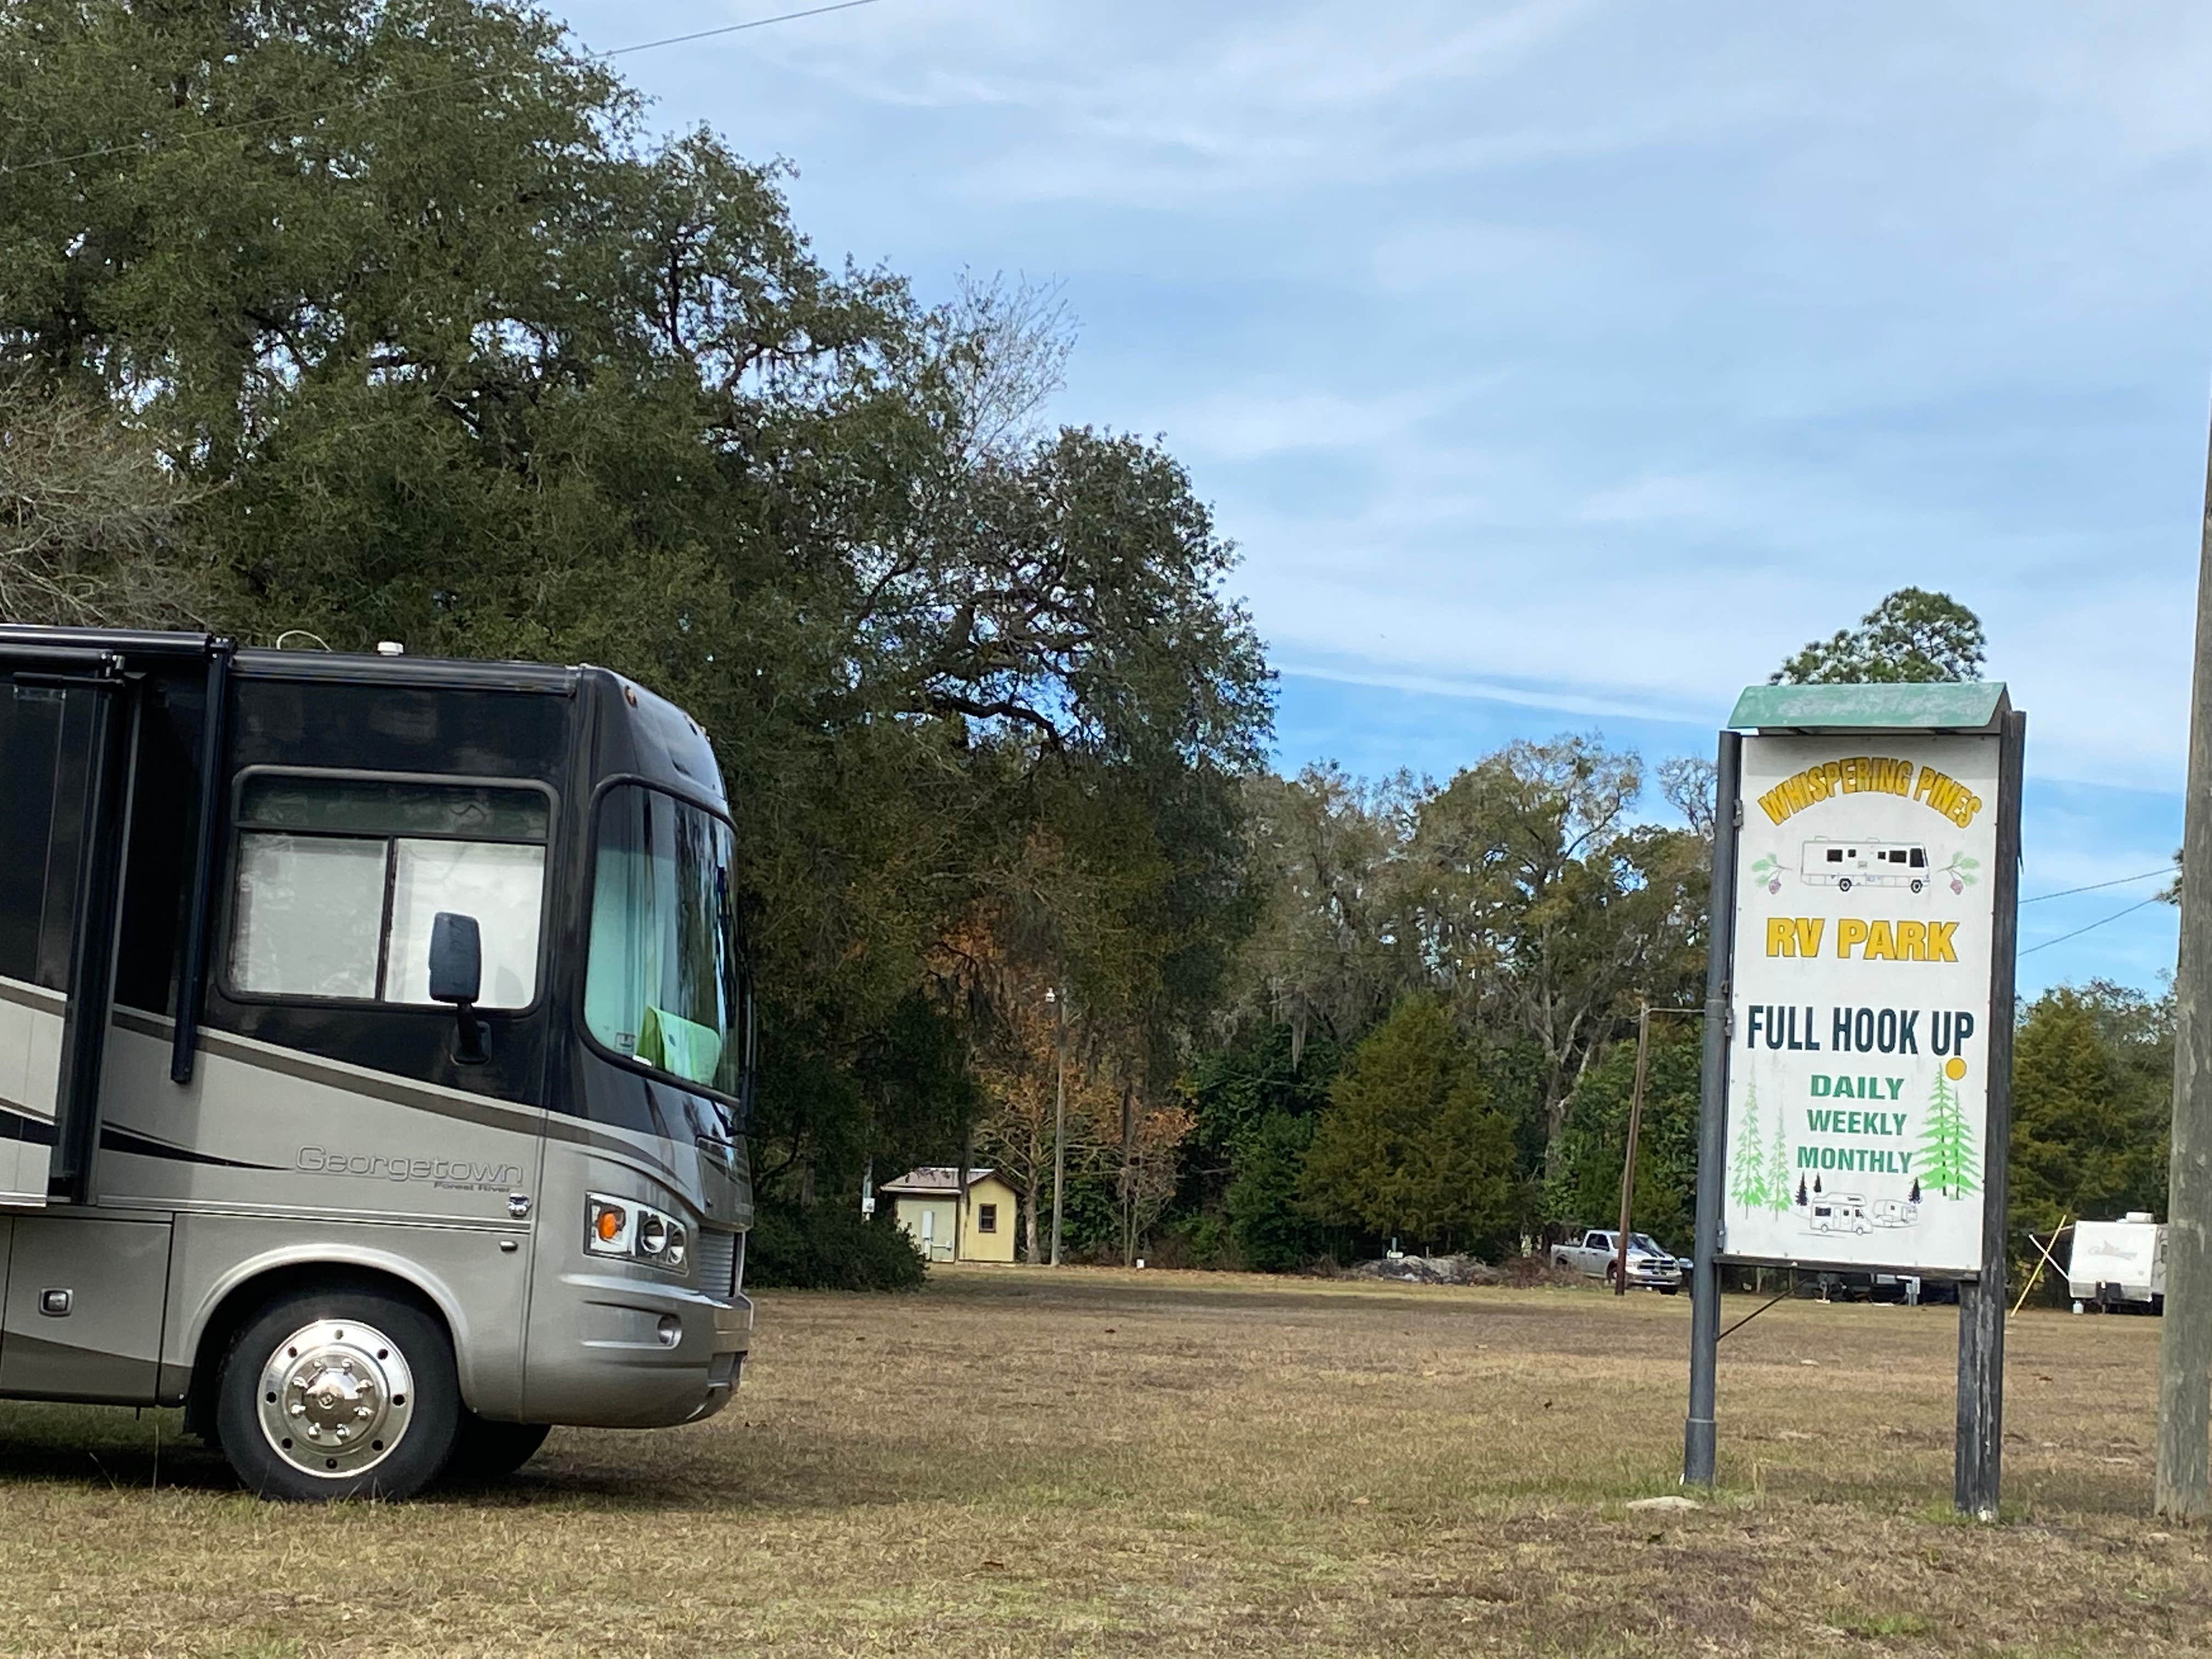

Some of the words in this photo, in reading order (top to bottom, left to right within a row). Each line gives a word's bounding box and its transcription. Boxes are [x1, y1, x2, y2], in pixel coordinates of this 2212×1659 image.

[1758, 757, 1913, 826] WHISPERING
[1914, 766, 1982, 828] PINES
[1766, 917, 1825, 958] RV
[1837, 918, 1960, 962] PARK
[1747, 1005, 1820, 1051] FULL
[1831, 1007, 1920, 1054] HOOK
[1931, 1011, 1974, 1056] UP
[1810, 1074, 1905, 1101] DAILY
[1807, 1109, 1908, 1136] WEEKLY
[297, 1146, 523, 1183] Georgetown
[1797, 1146, 1914, 1173] MONTHLY
